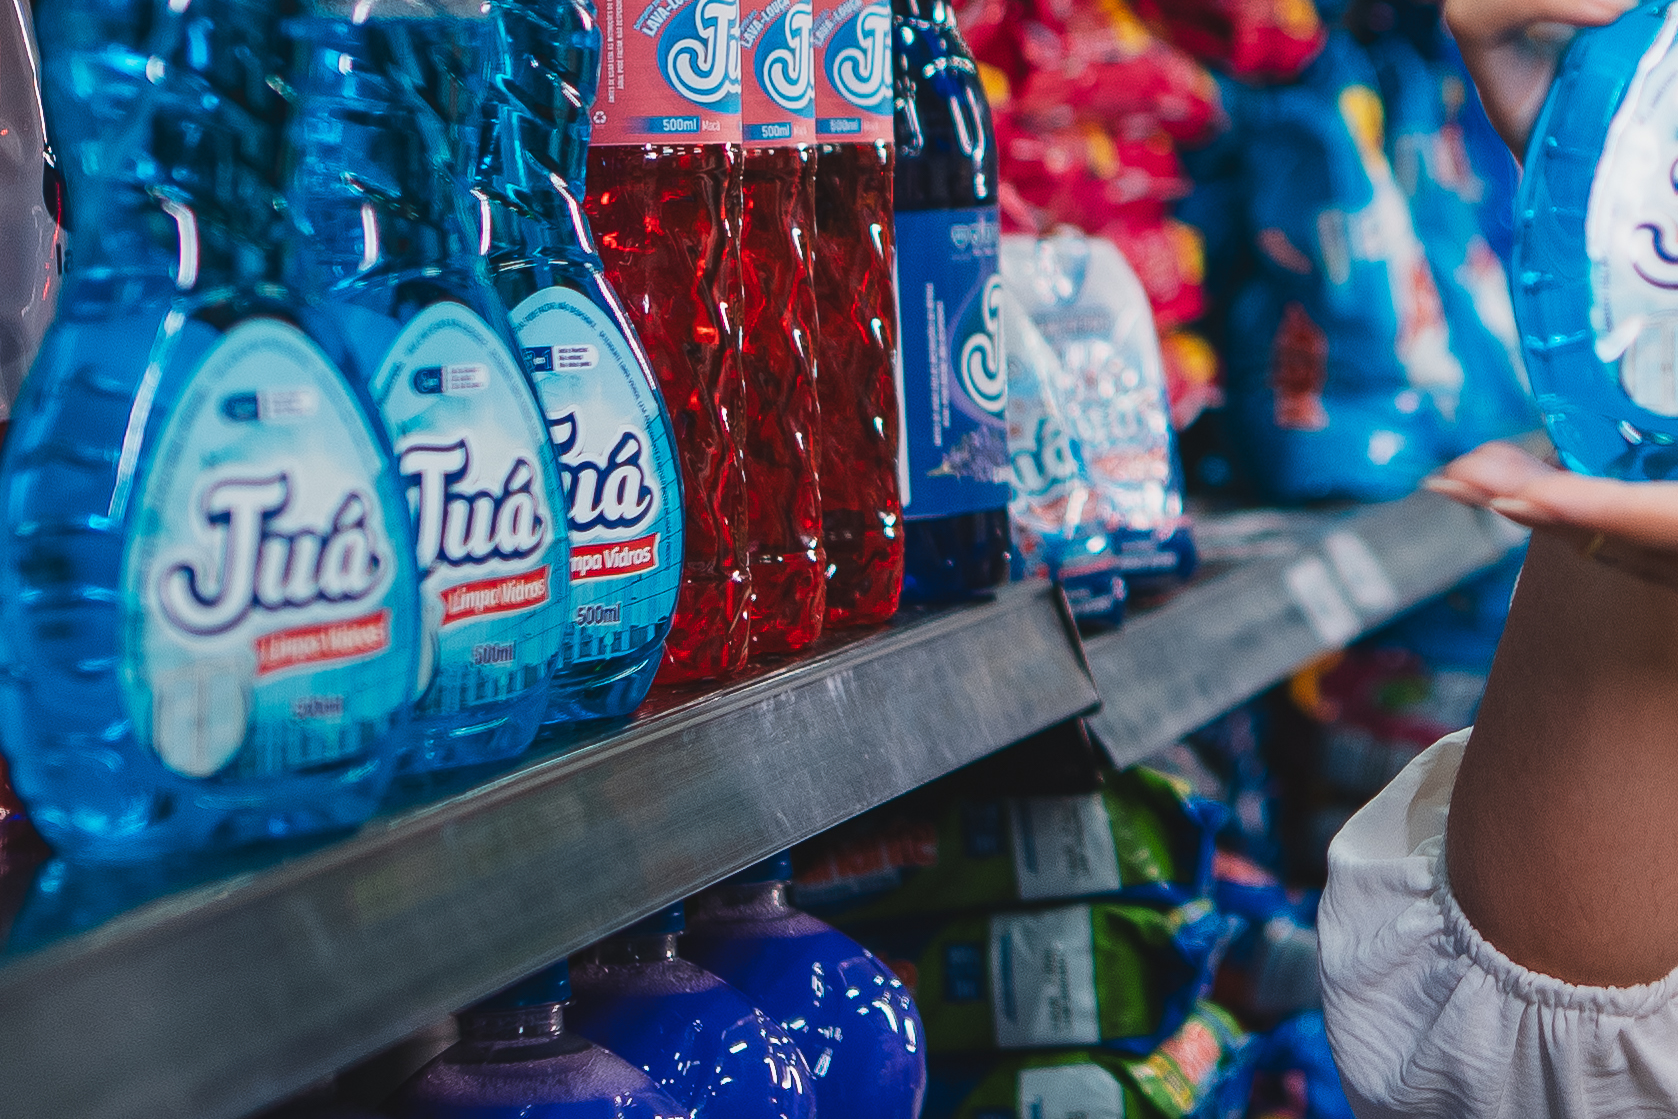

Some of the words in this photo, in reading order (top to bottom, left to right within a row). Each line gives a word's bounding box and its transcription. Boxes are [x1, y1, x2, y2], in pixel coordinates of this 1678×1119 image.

[662, 118, 697, 131] 500ml
[761, 124, 790, 138] 500ml
[549, 414, 654, 532] uá
[159, 469, 387, 636] Juá
[571, 550, 602, 577] mpa
[602, 545, 651, 569] Vidros
[577, 602, 620, 626] 500ml
[472, 640, 516, 666] 500ml
